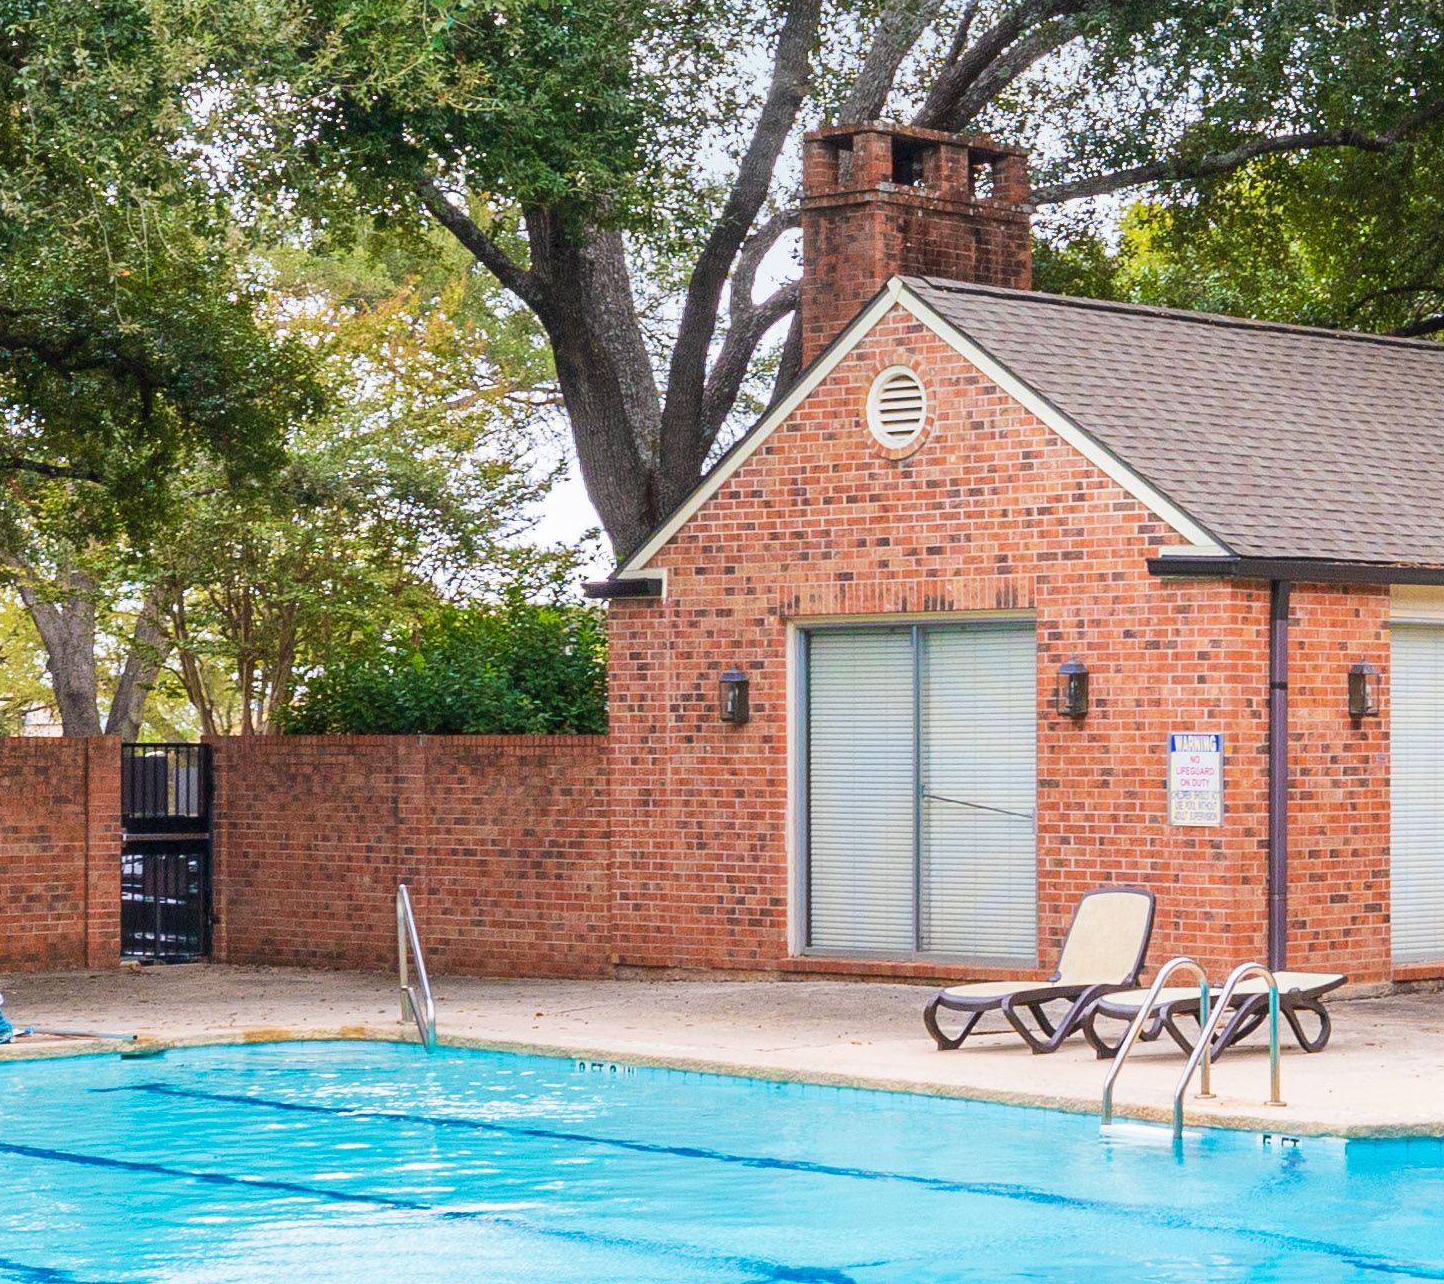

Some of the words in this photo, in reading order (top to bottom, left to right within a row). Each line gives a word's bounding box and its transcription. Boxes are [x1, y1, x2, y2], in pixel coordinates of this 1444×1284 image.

[1174, 735, 1217, 752] WARNING
[1190, 756, 1200, 764] NO
[1176, 767, 1214, 775] LIFEGUARD
[1180, 778, 1190, 787] ON
[1192, 778, 1210, 787] DUTY
